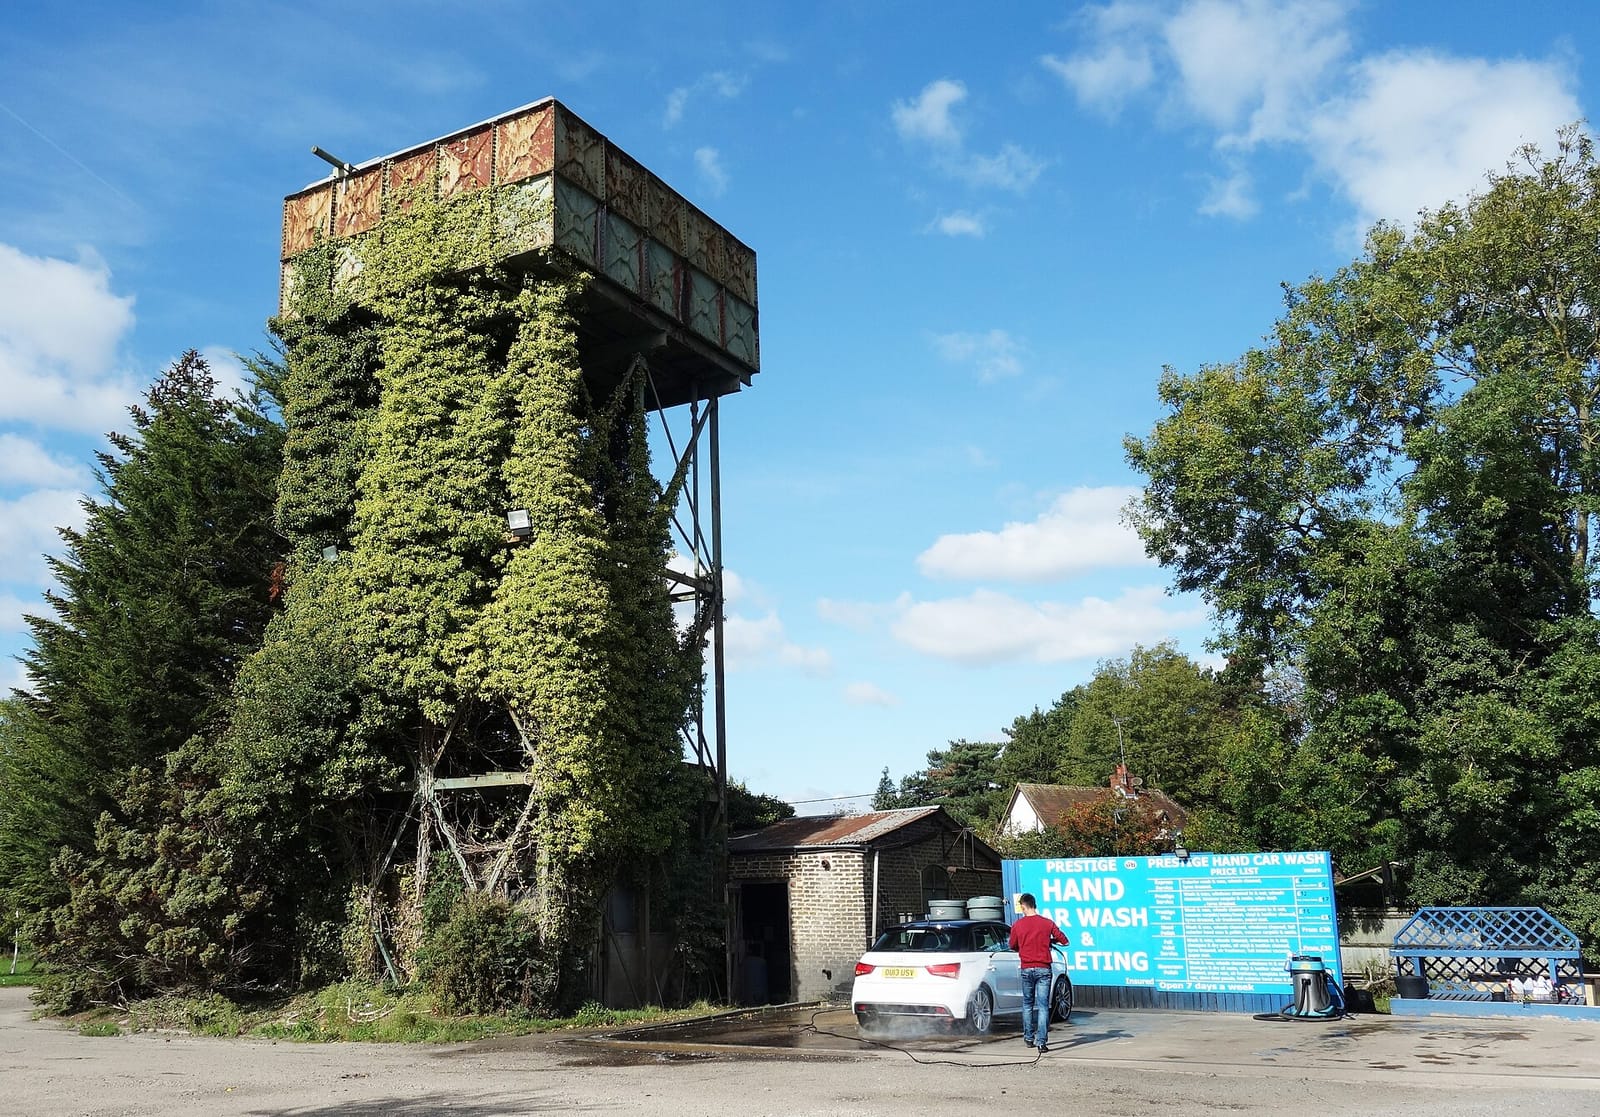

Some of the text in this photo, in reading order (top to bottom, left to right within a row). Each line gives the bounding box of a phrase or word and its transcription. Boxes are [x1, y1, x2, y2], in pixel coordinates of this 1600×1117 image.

[1046, 859, 1117, 873] PRESTIGE
[1212, 855, 1250, 867] HAND
[1253, 854, 1280, 866] CAR
[1283, 853, 1326, 865] WASH
[1210, 867, 1259, 876] PRICE LIST
[1042, 878, 1125, 902] HAND
[1036, 907, 1072, 928] AR
[1076, 907, 1148, 928] WASH
[1081, 931, 1095, 947] &
[1051, 951, 1149, 971] LETING
[1125, 977, 1155, 986] Insured
[1159, 981, 1184, 991] Open
[1194, 983, 1217, 991] days
[1228, 983, 1255, 991] week
